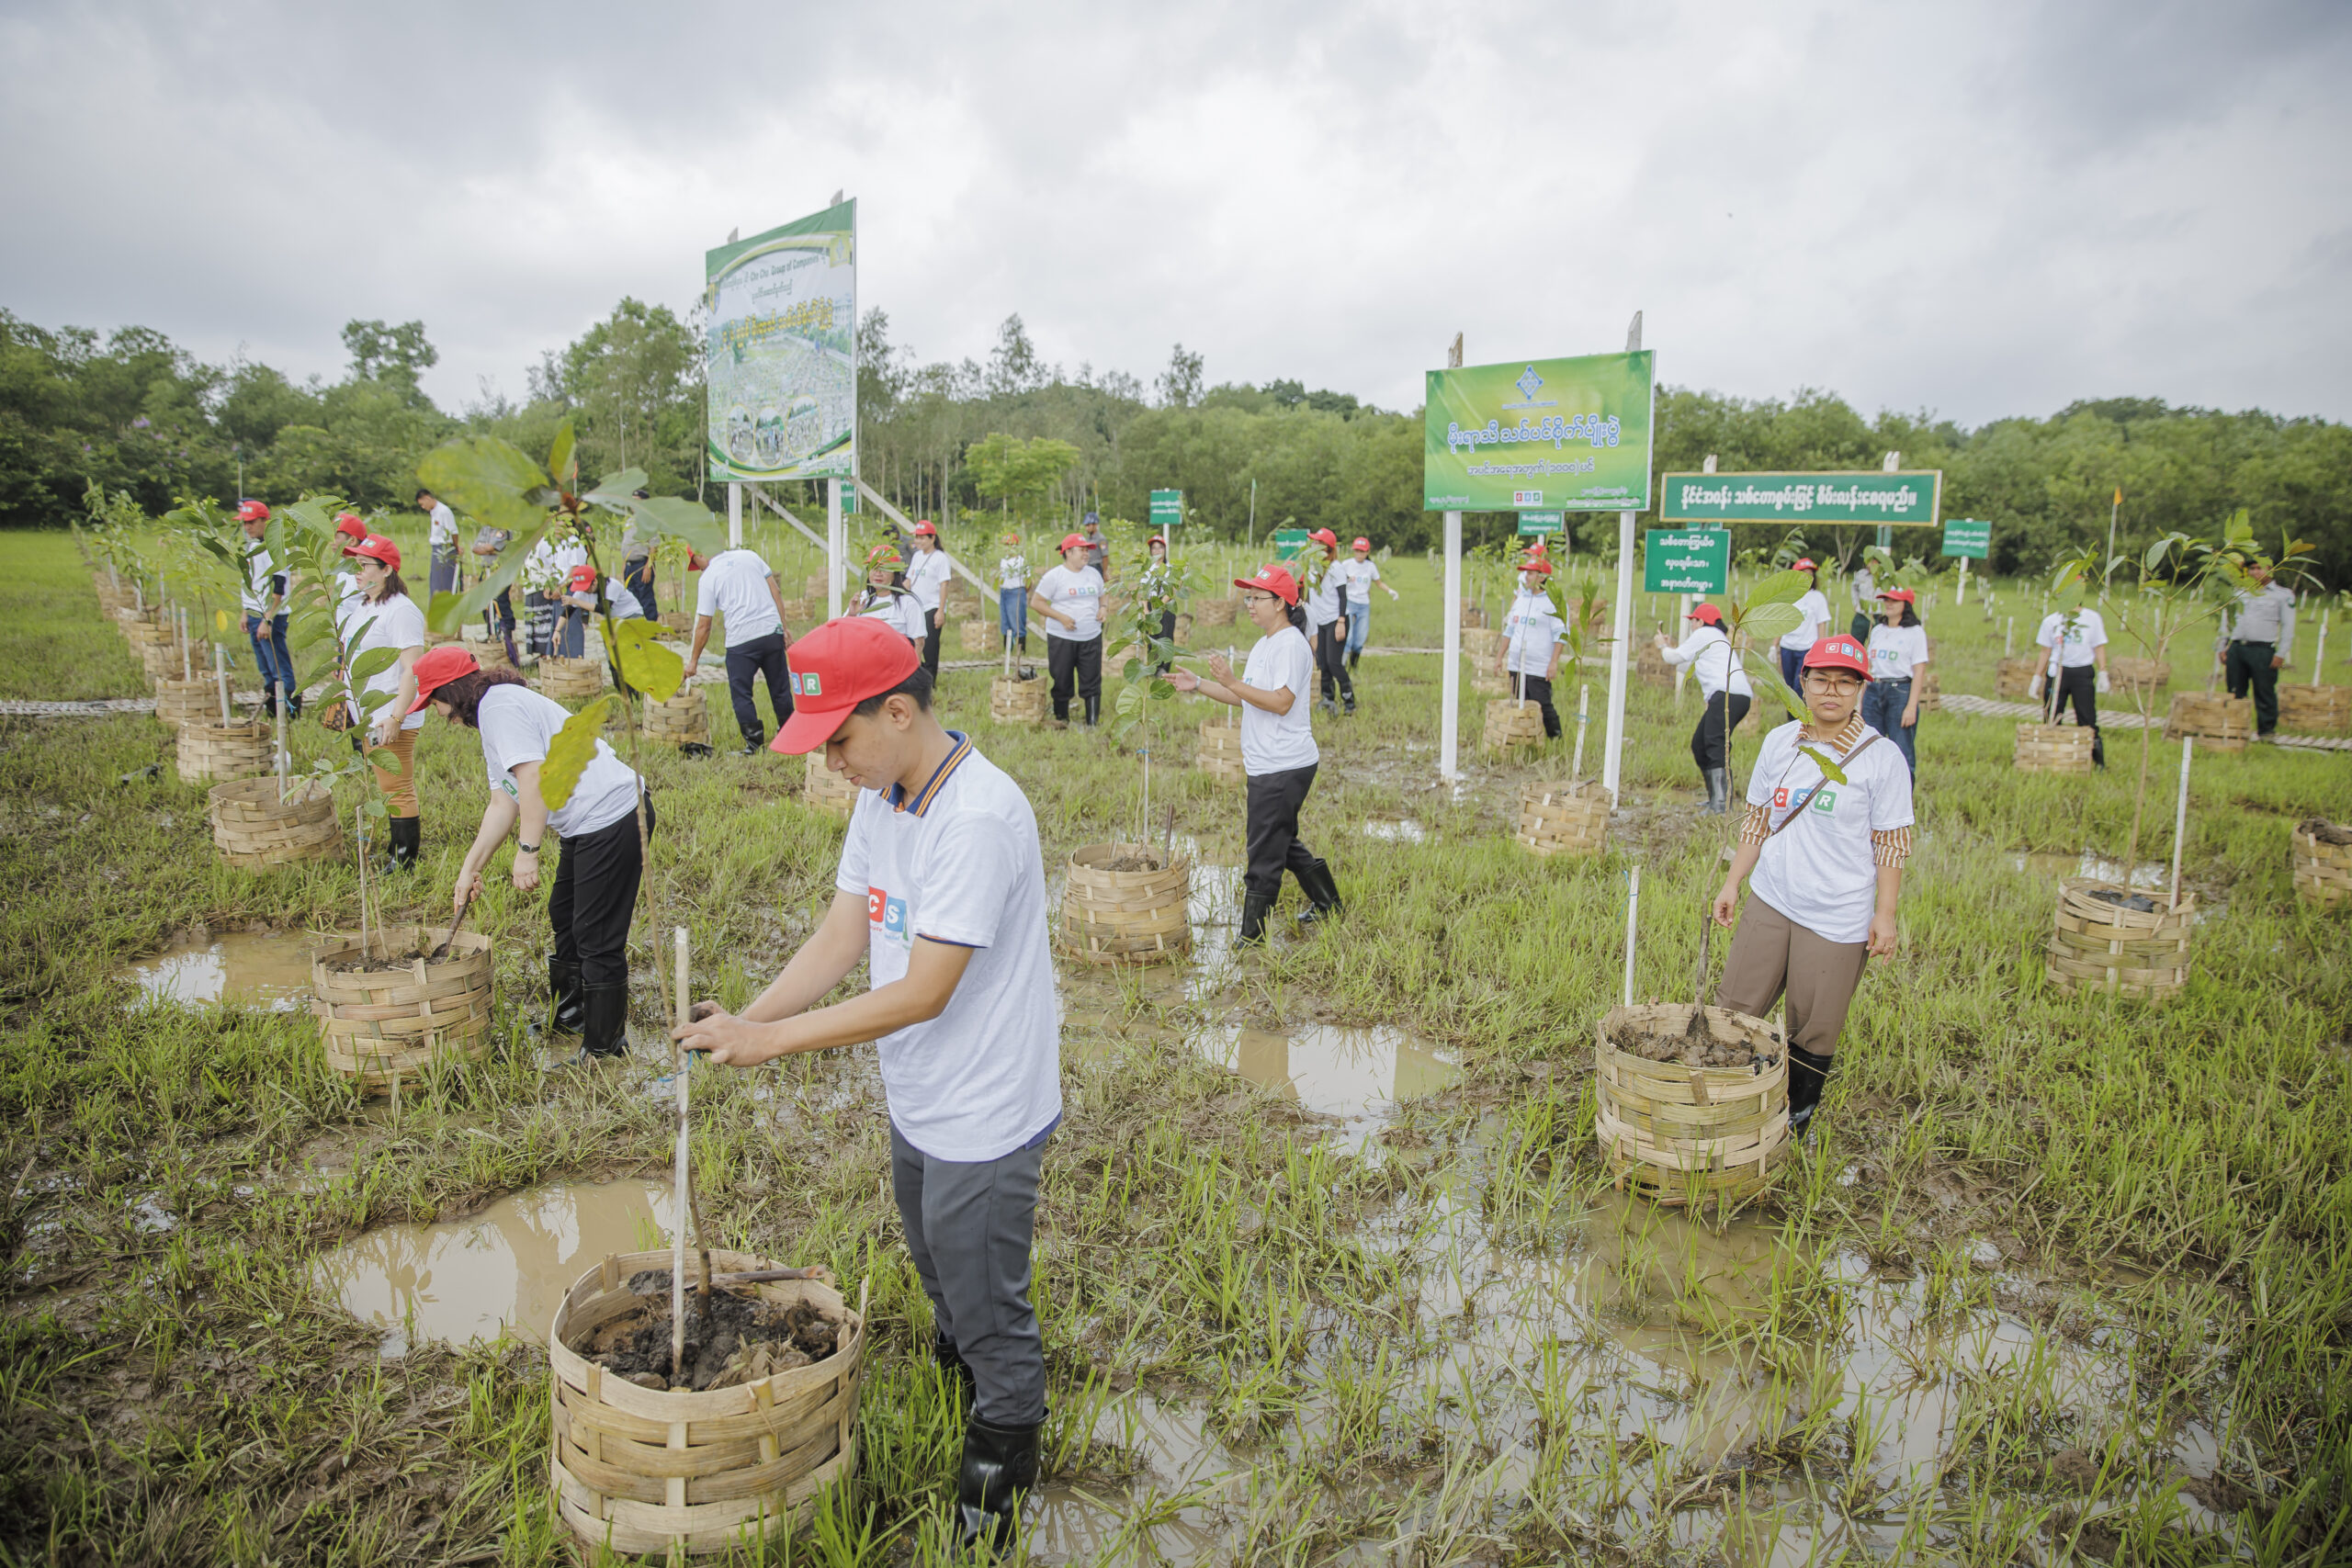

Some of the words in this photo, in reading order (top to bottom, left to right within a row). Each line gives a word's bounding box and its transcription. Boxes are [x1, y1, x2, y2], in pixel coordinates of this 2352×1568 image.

[771, 263, 786, 277] Group
[786, 260, 793, 272] of
[793, 254, 820, 271] Companies
[1448, 420, 1498, 454] မိုးရာသီ
[1500, 413, 1620, 450] သစ်ပင်စိုက်ပျိုးပွဲ
